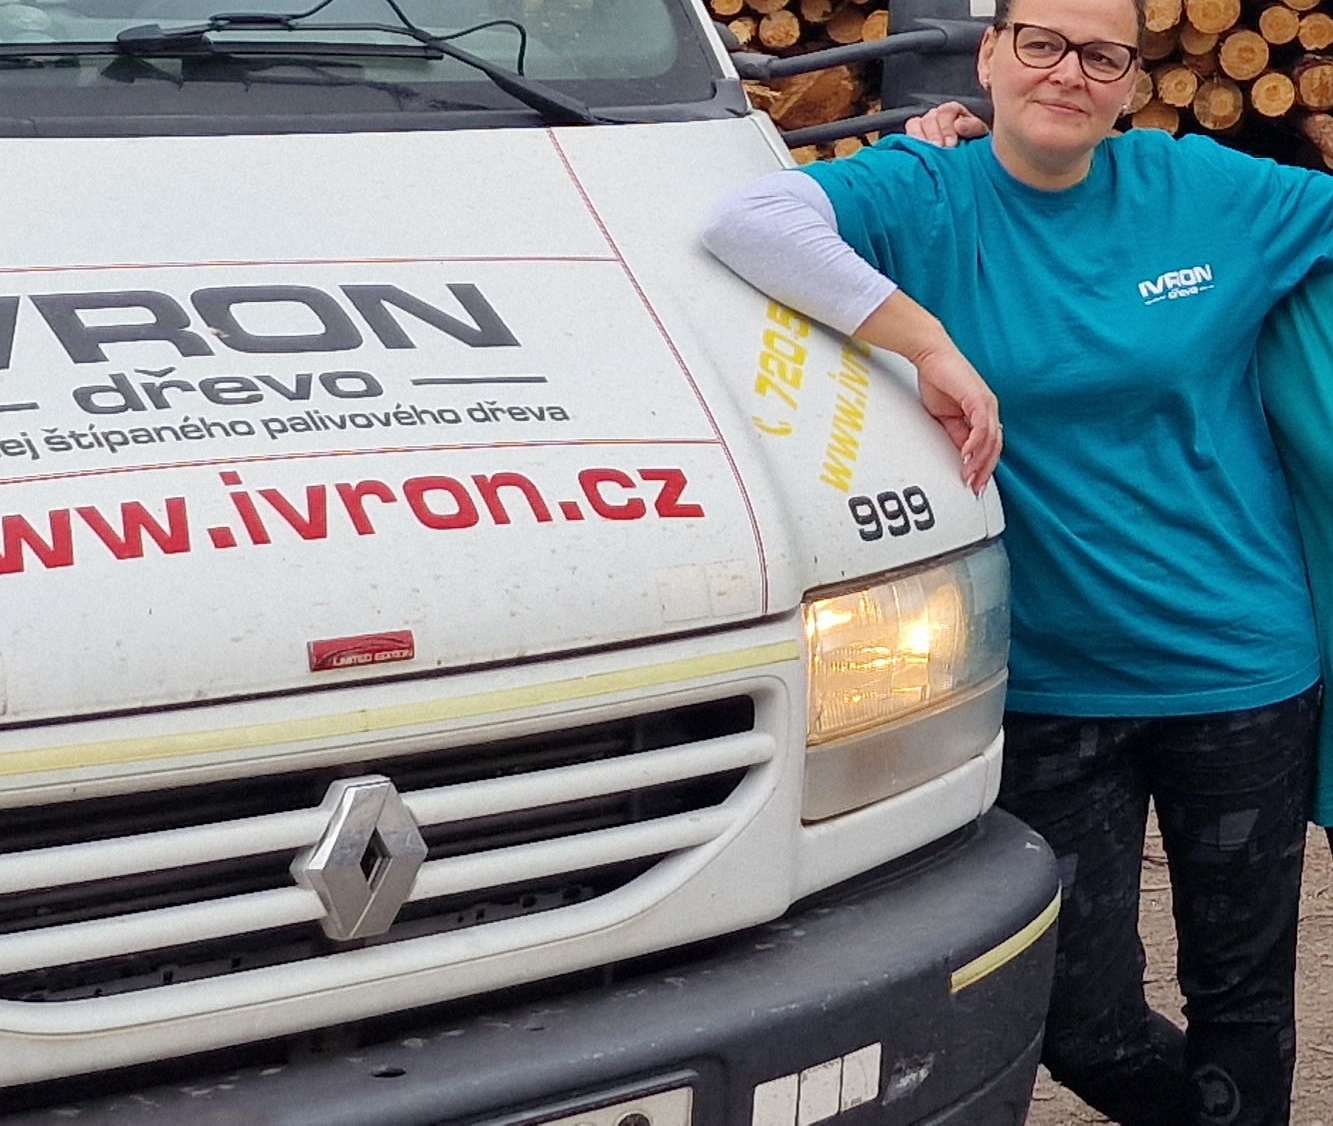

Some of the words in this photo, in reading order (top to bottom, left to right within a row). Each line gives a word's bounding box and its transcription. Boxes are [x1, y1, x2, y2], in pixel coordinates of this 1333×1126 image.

[1138, 264, 1213, 299] IVRON
[0, 283, 522, 370] RON
[72, 366, 384, 415] dřevo
[0, 432, 40, 460] ej
[41, 415, 256, 453] štípaného
[260, 402, 463, 440] palivového
[467, 400, 571, 424] dřeva
[848, 485, 936, 542] 999
